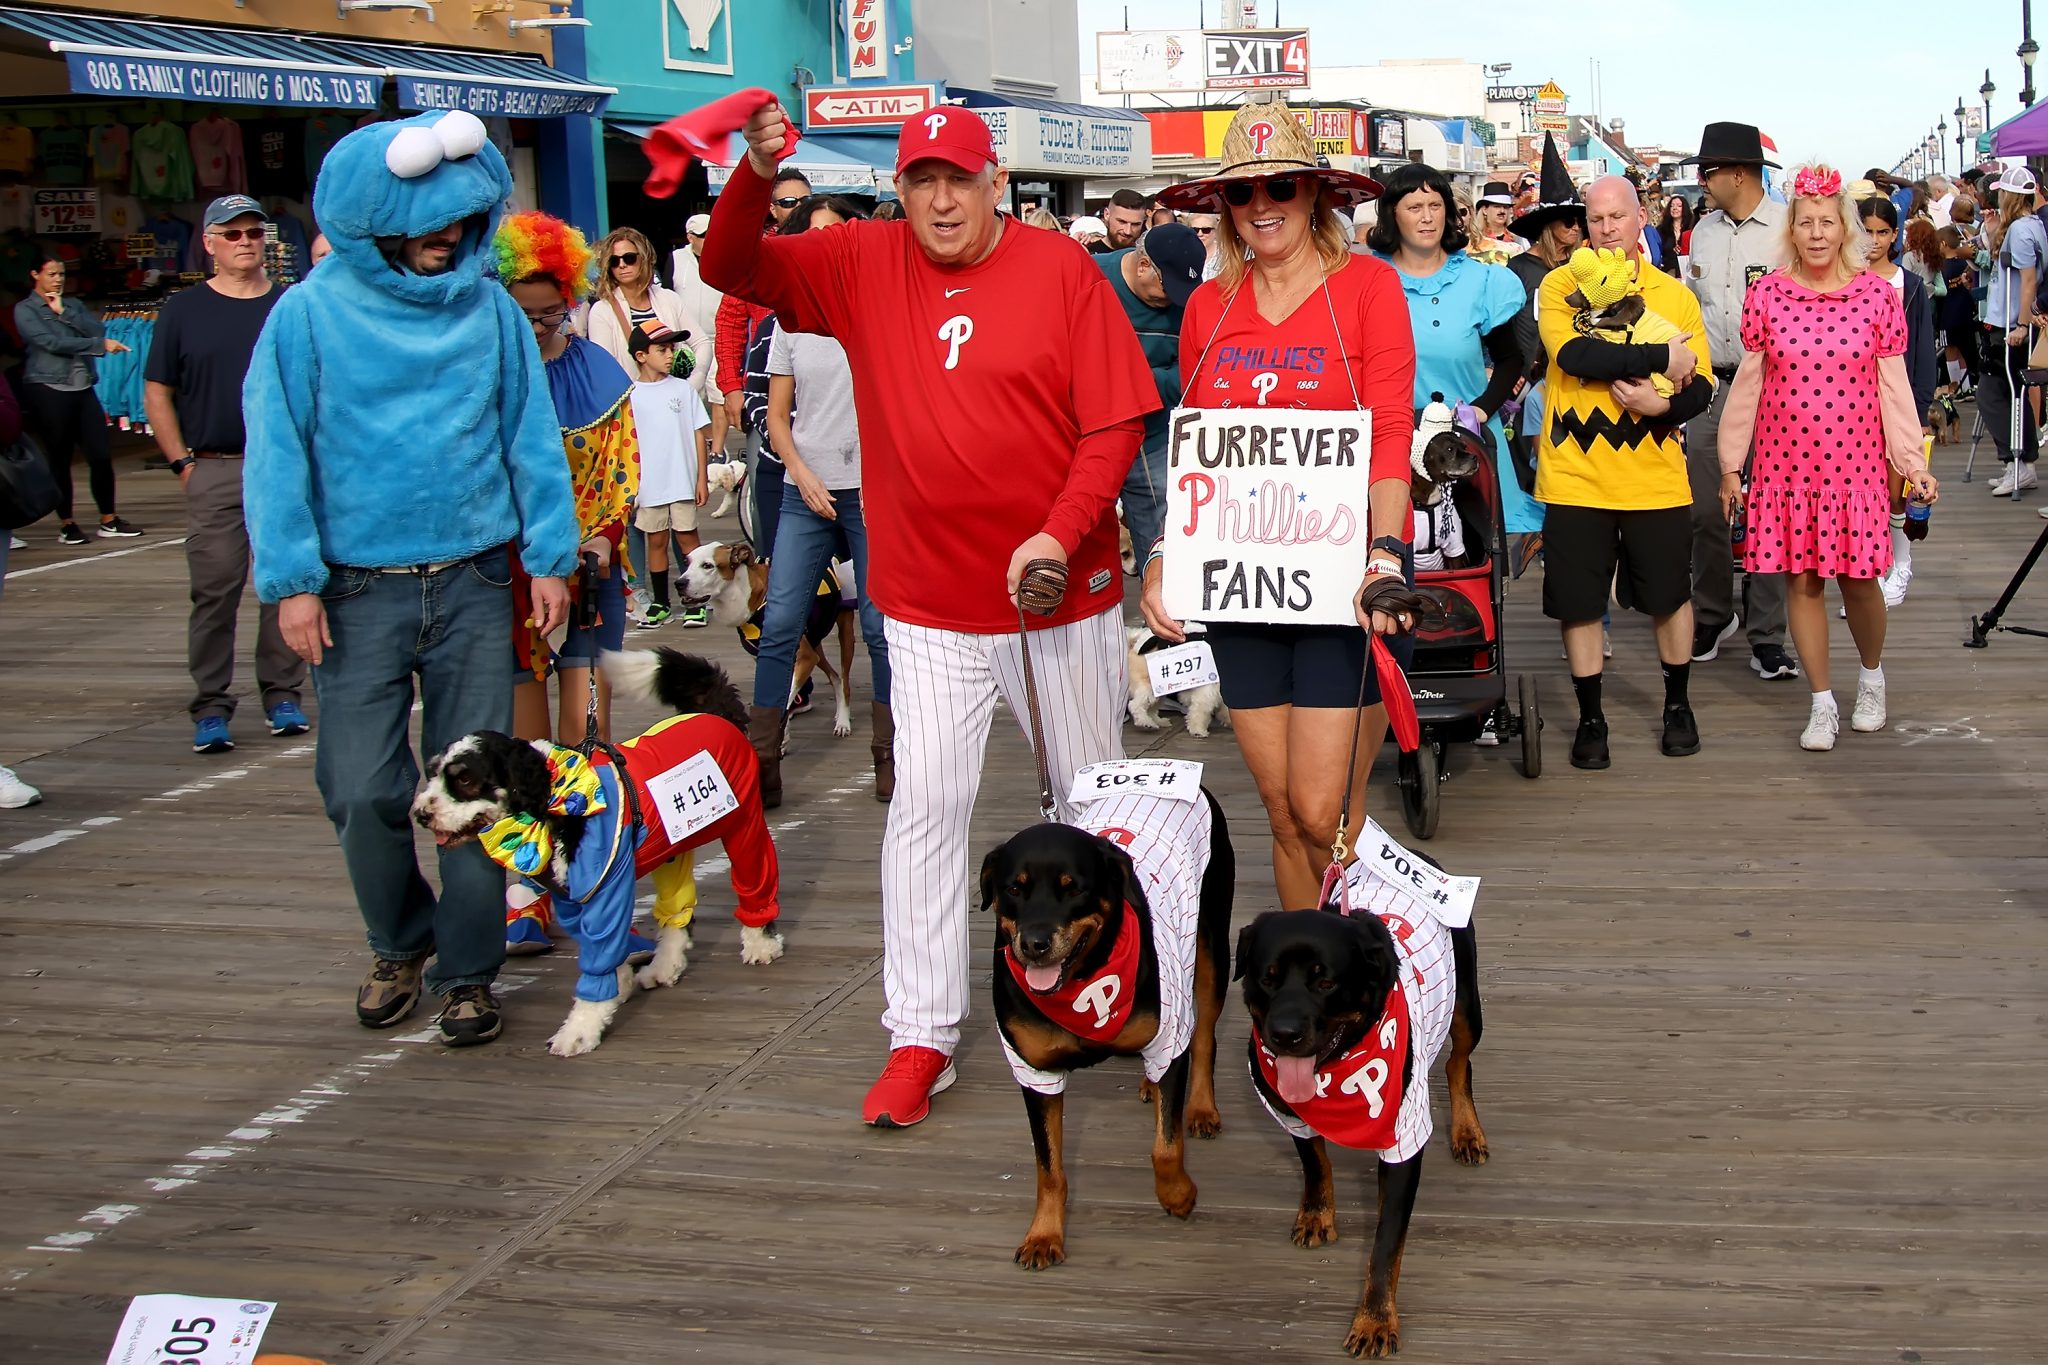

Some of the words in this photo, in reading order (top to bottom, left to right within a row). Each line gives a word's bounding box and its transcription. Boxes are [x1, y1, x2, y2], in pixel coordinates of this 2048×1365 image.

[853, 0, 876, 68] FUN
[1207, 38, 1283, 76] EXIT
[1284, 41, 1306, 73] 4
[87, 61, 122, 90] 808
[126, 63, 185, 94] FAMILY
[190, 67, 268, 100] CLOTHING
[274, 74, 284, 101] 6
[288, 75, 329, 103] MOS.
[330, 77, 352, 104] TO
[355, 79, 376, 104] 5X
[412, 82, 462, 109] JEWELRY
[468, 87, 498, 112] GIFTS
[504, 90, 539, 115] BEACH
[1209, 76, 1254, 87] ESCAPE
[1259, 76, 1304, 86] ROOMS
[1486, 87, 1514, 99] PLAYA
[845, 99, 901, 115] ATM
[923, 113, 948, 140] P
[1039, 116, 1074, 149] FUDGE
[1090, 123, 1132, 152] KITCHEN
[1248, 120, 1275, 156] P
[1043, 150, 1063, 163] PREMIUM
[1064, 152, 1091, 166] CHOCOLATES
[1316, 141, 1344, 155] IENCE
[37, 191, 96, 202] SALE
[937, 314, 974, 370] P
[1213, 346, 1328, 375] PHILLIES
[1213, 377, 1230, 389] Est.
[1251, 371, 1279, 406] P
[1296, 380, 1320, 390] 1883
[1170, 411, 1359, 468] FURREVER
[1178, 472, 1356, 546] Phillies
[1202, 559, 1312, 611] FANS
[1161, 665, 1170, 678] #
[1174, 655, 1202, 675] 297
[673, 792, 686, 814] #
[688, 774, 719, 806] 164
[1096, 773, 1150, 789] 303
[1159, 772, 1177, 785] #
[1380, 843, 1426, 889] 304
[1432, 889, 1449, 905] #
[1072, 974, 1120, 1029] P
[1340, 1057, 1389, 1119] P
[130, 1314, 149, 1344] Parade
